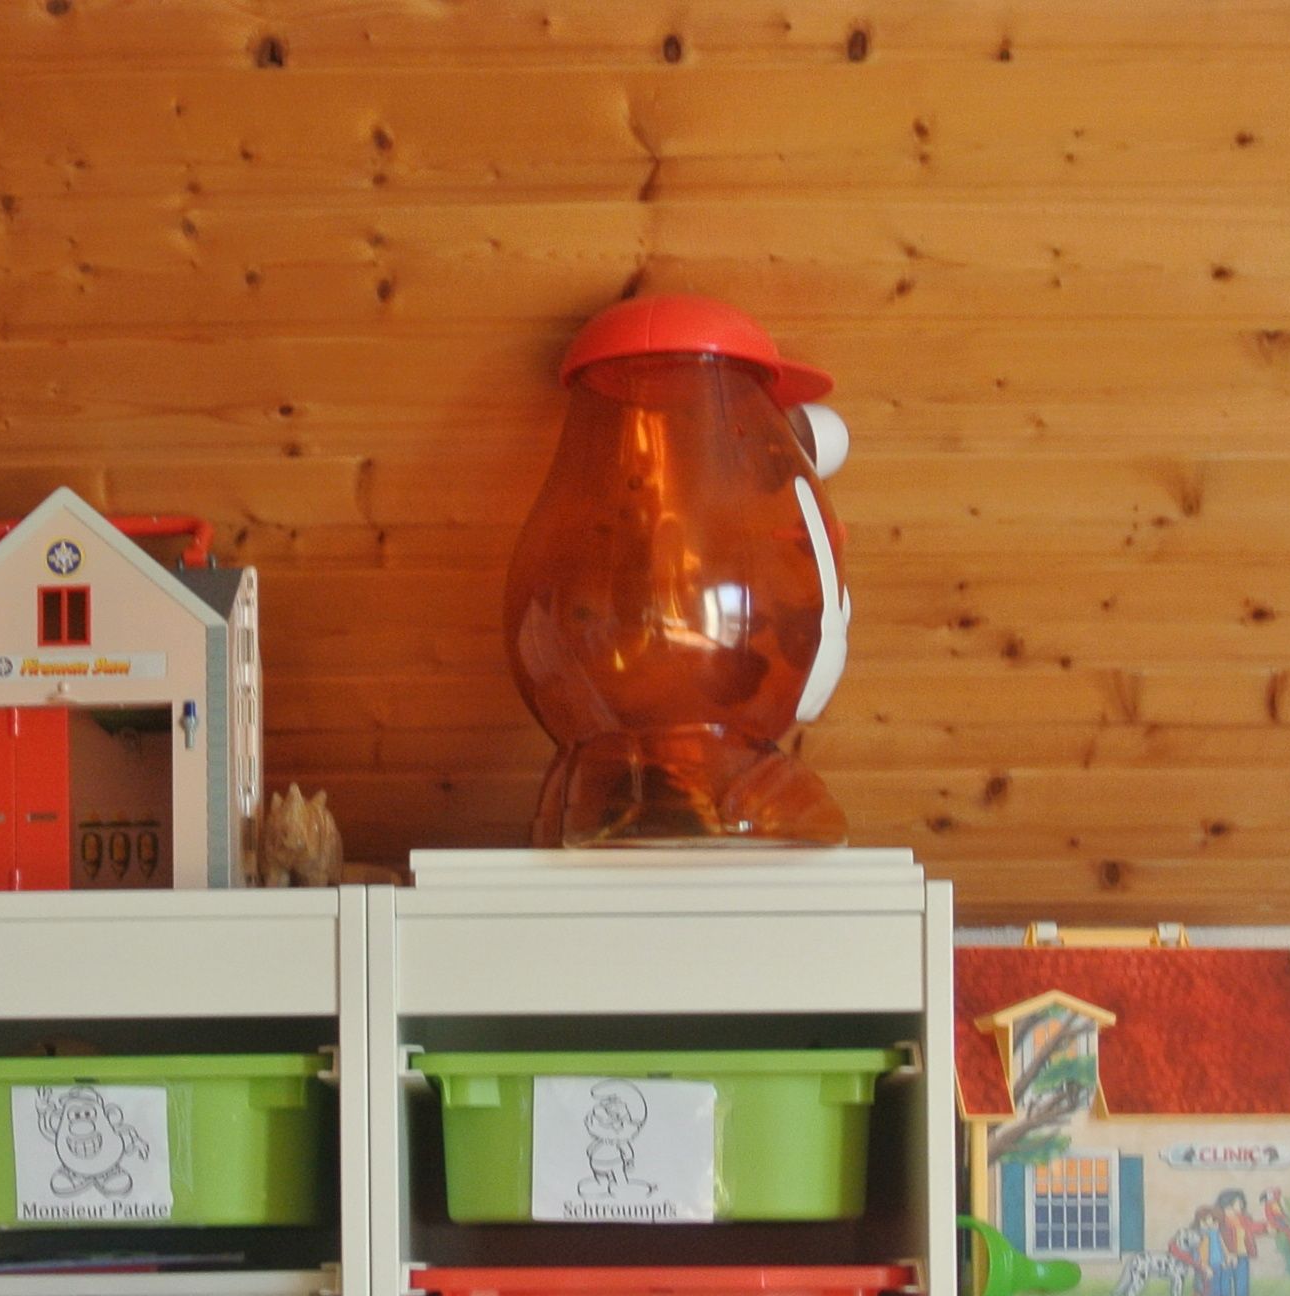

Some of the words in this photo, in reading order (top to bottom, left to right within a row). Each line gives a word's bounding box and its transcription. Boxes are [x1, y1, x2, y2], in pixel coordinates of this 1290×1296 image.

[1198, 1145, 1259, 1168] CLINIC
[22, 1200, 107, 1220] Monsieur
[112, 1200, 169, 1220] Patate
[563, 1199, 677, 1224] Schtroumpfs
